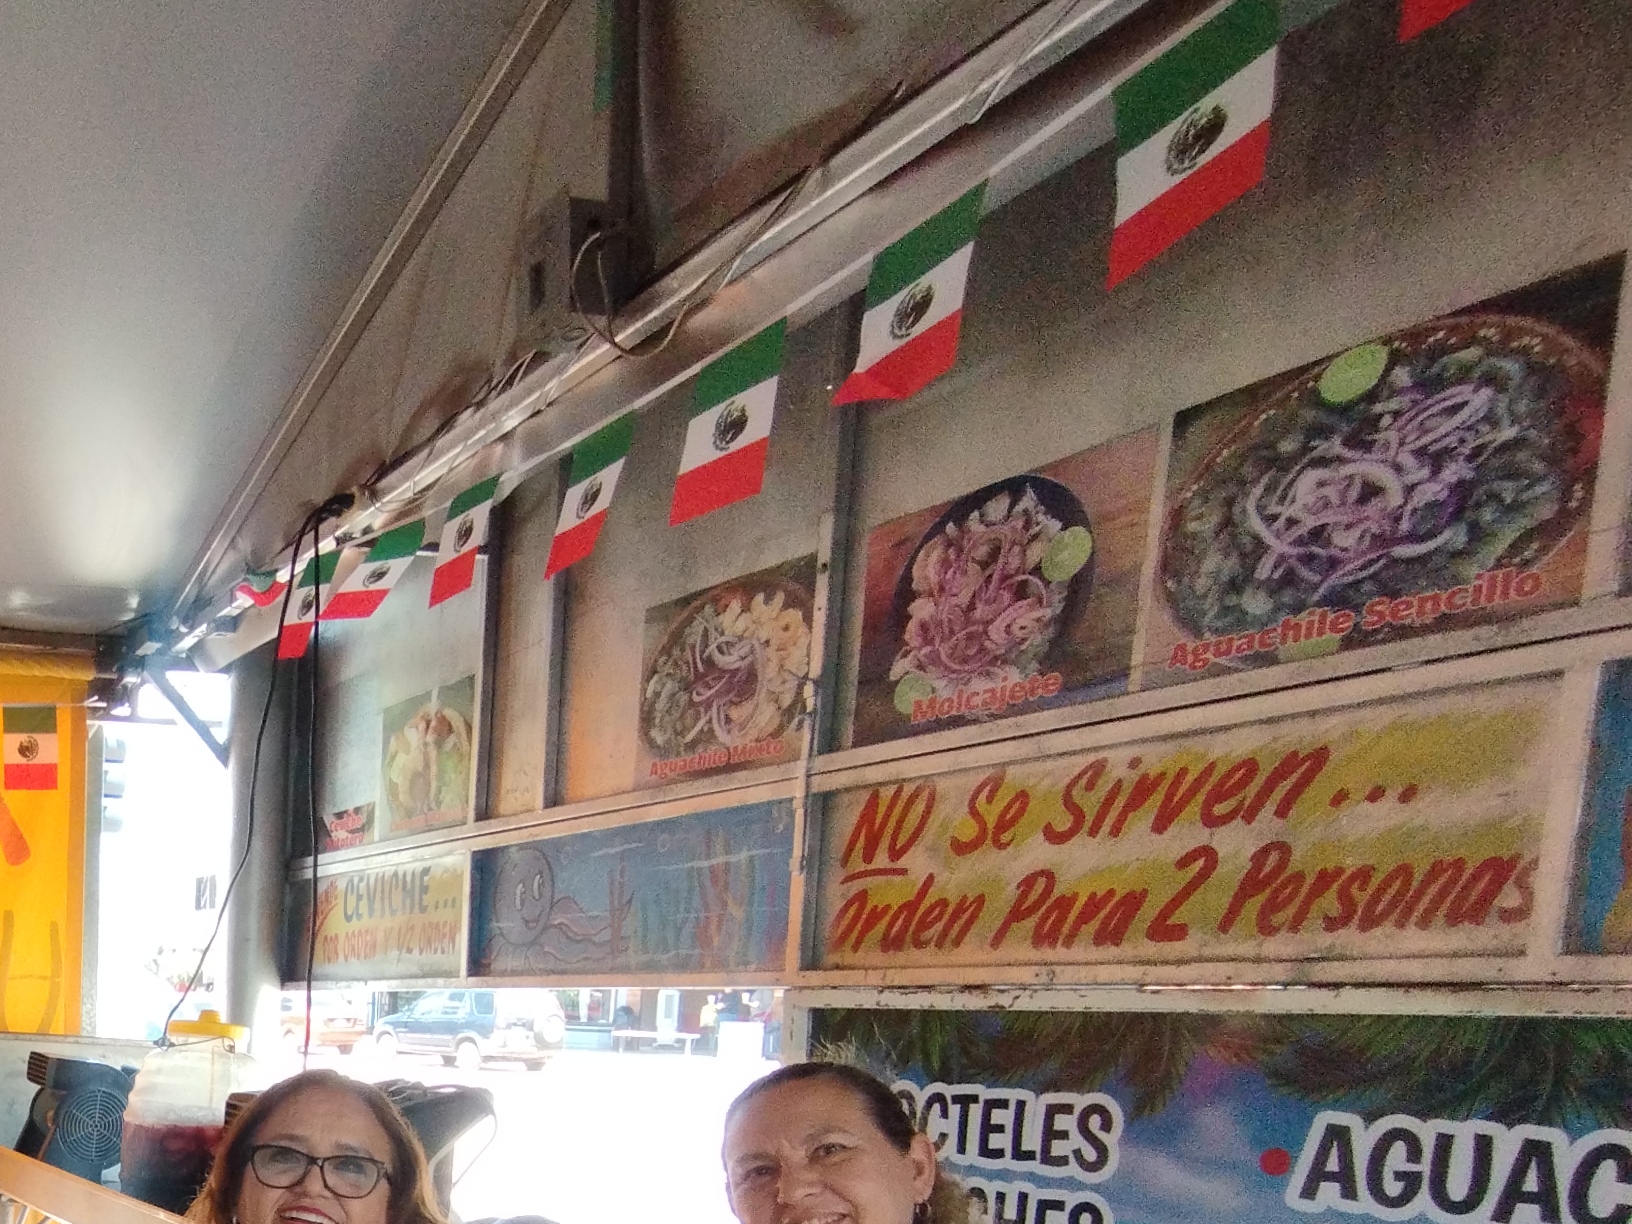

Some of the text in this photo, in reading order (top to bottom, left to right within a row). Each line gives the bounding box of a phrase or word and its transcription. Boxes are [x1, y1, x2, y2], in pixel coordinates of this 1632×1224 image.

[1168, 568, 1542, 671] Aguachile Sencillo
[910, 671, 1064, 723] Molcajete
[649, 749, 727, 779] Aguachile
[841, 779, 936, 868] NO
[950, 765, 1034, 858] Se
[829, 840, 1541, 954] Orden Para 2 Personas
[344, 926, 378, 962] ORDEN
[419, 919, 461, 957] ORDEN
